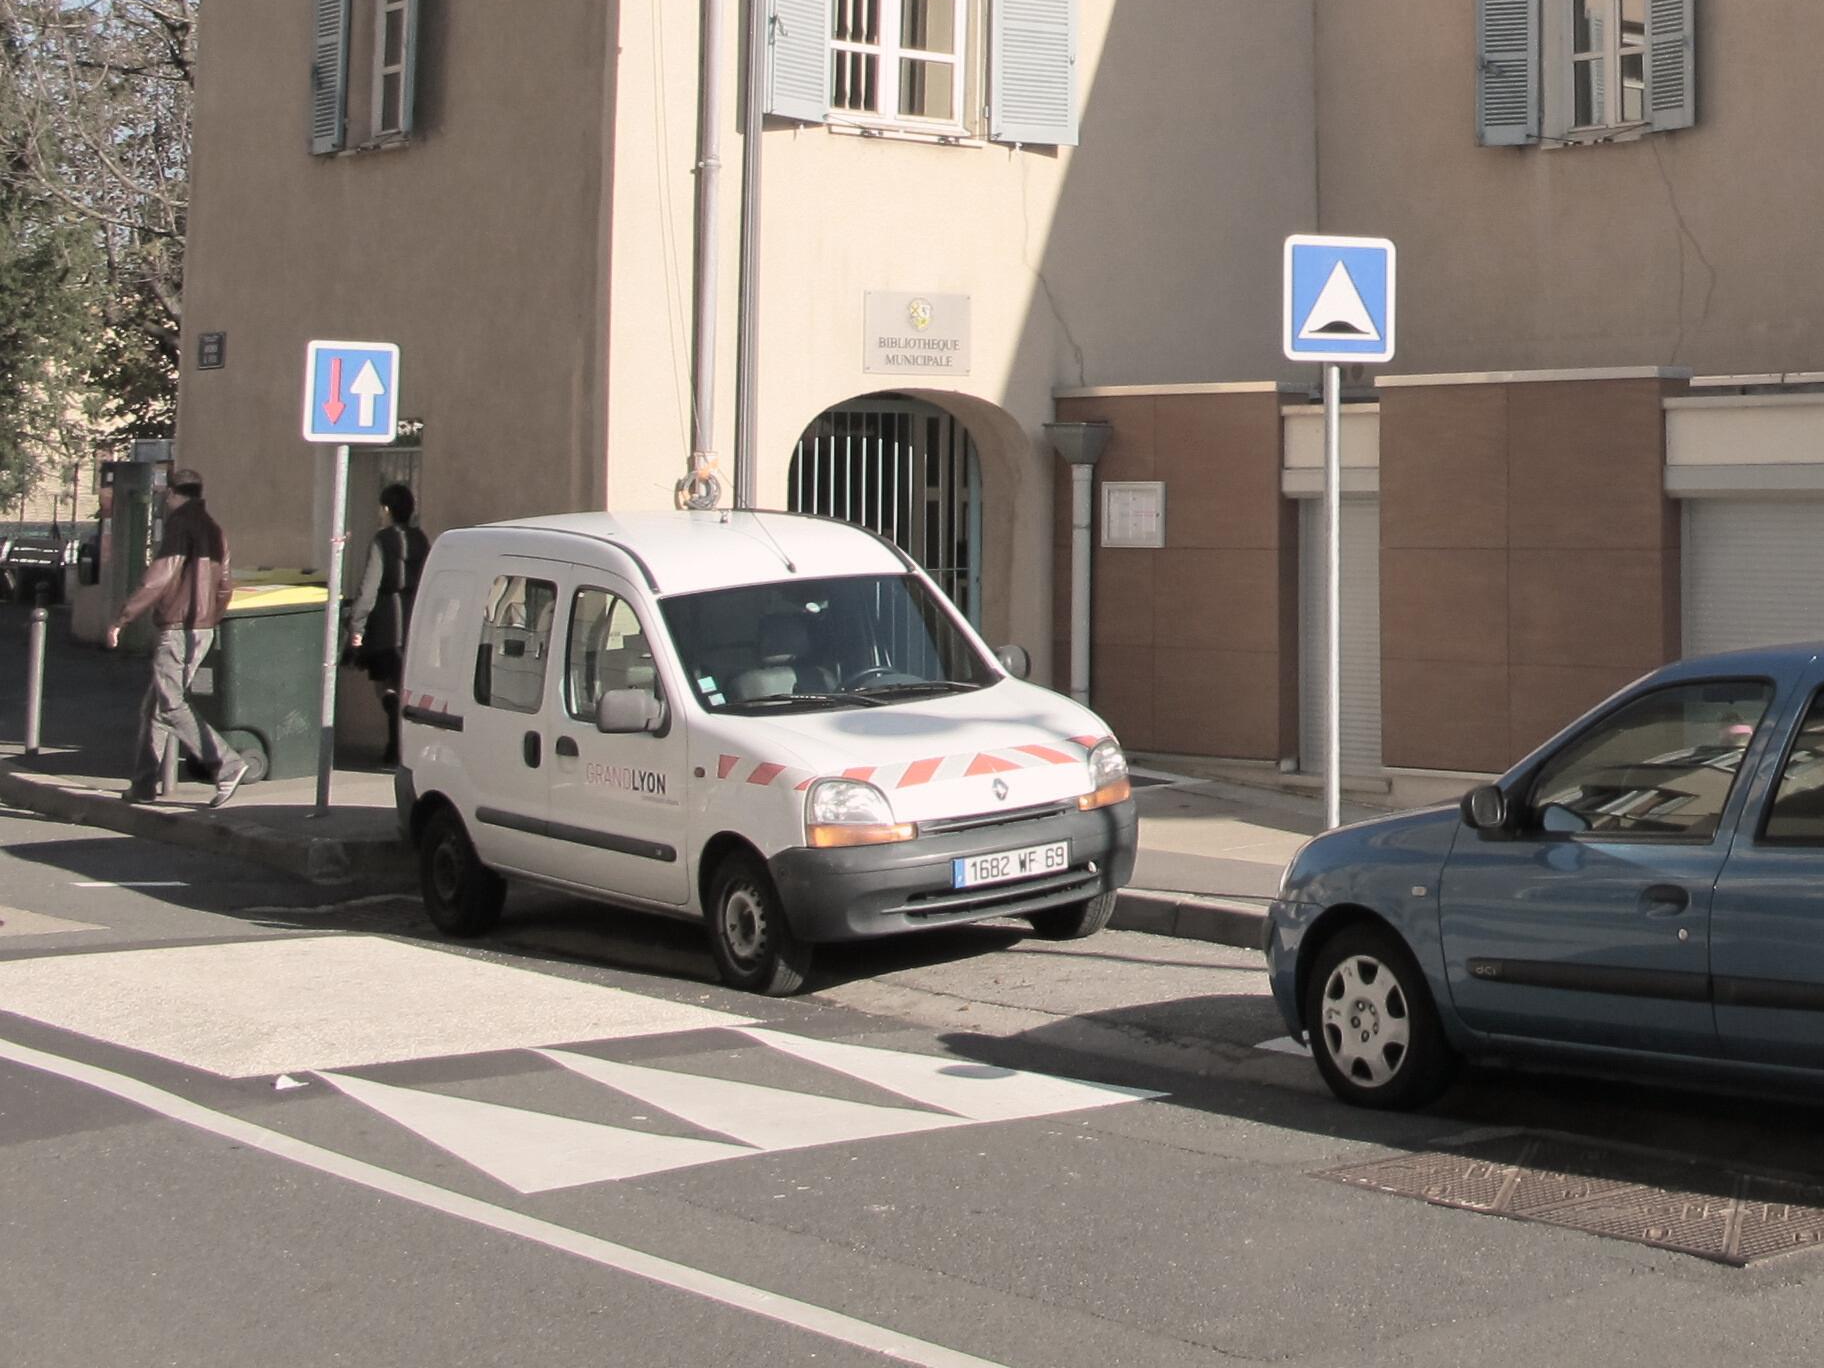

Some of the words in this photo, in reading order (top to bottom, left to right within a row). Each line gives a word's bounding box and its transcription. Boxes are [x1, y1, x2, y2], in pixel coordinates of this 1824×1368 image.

[886, 354, 953, 367] MUNICIPALE
[970, 854, 1010, 882] 1682
[1018, 850, 1037, 874] WF
[1045, 846, 1065, 868] 69
